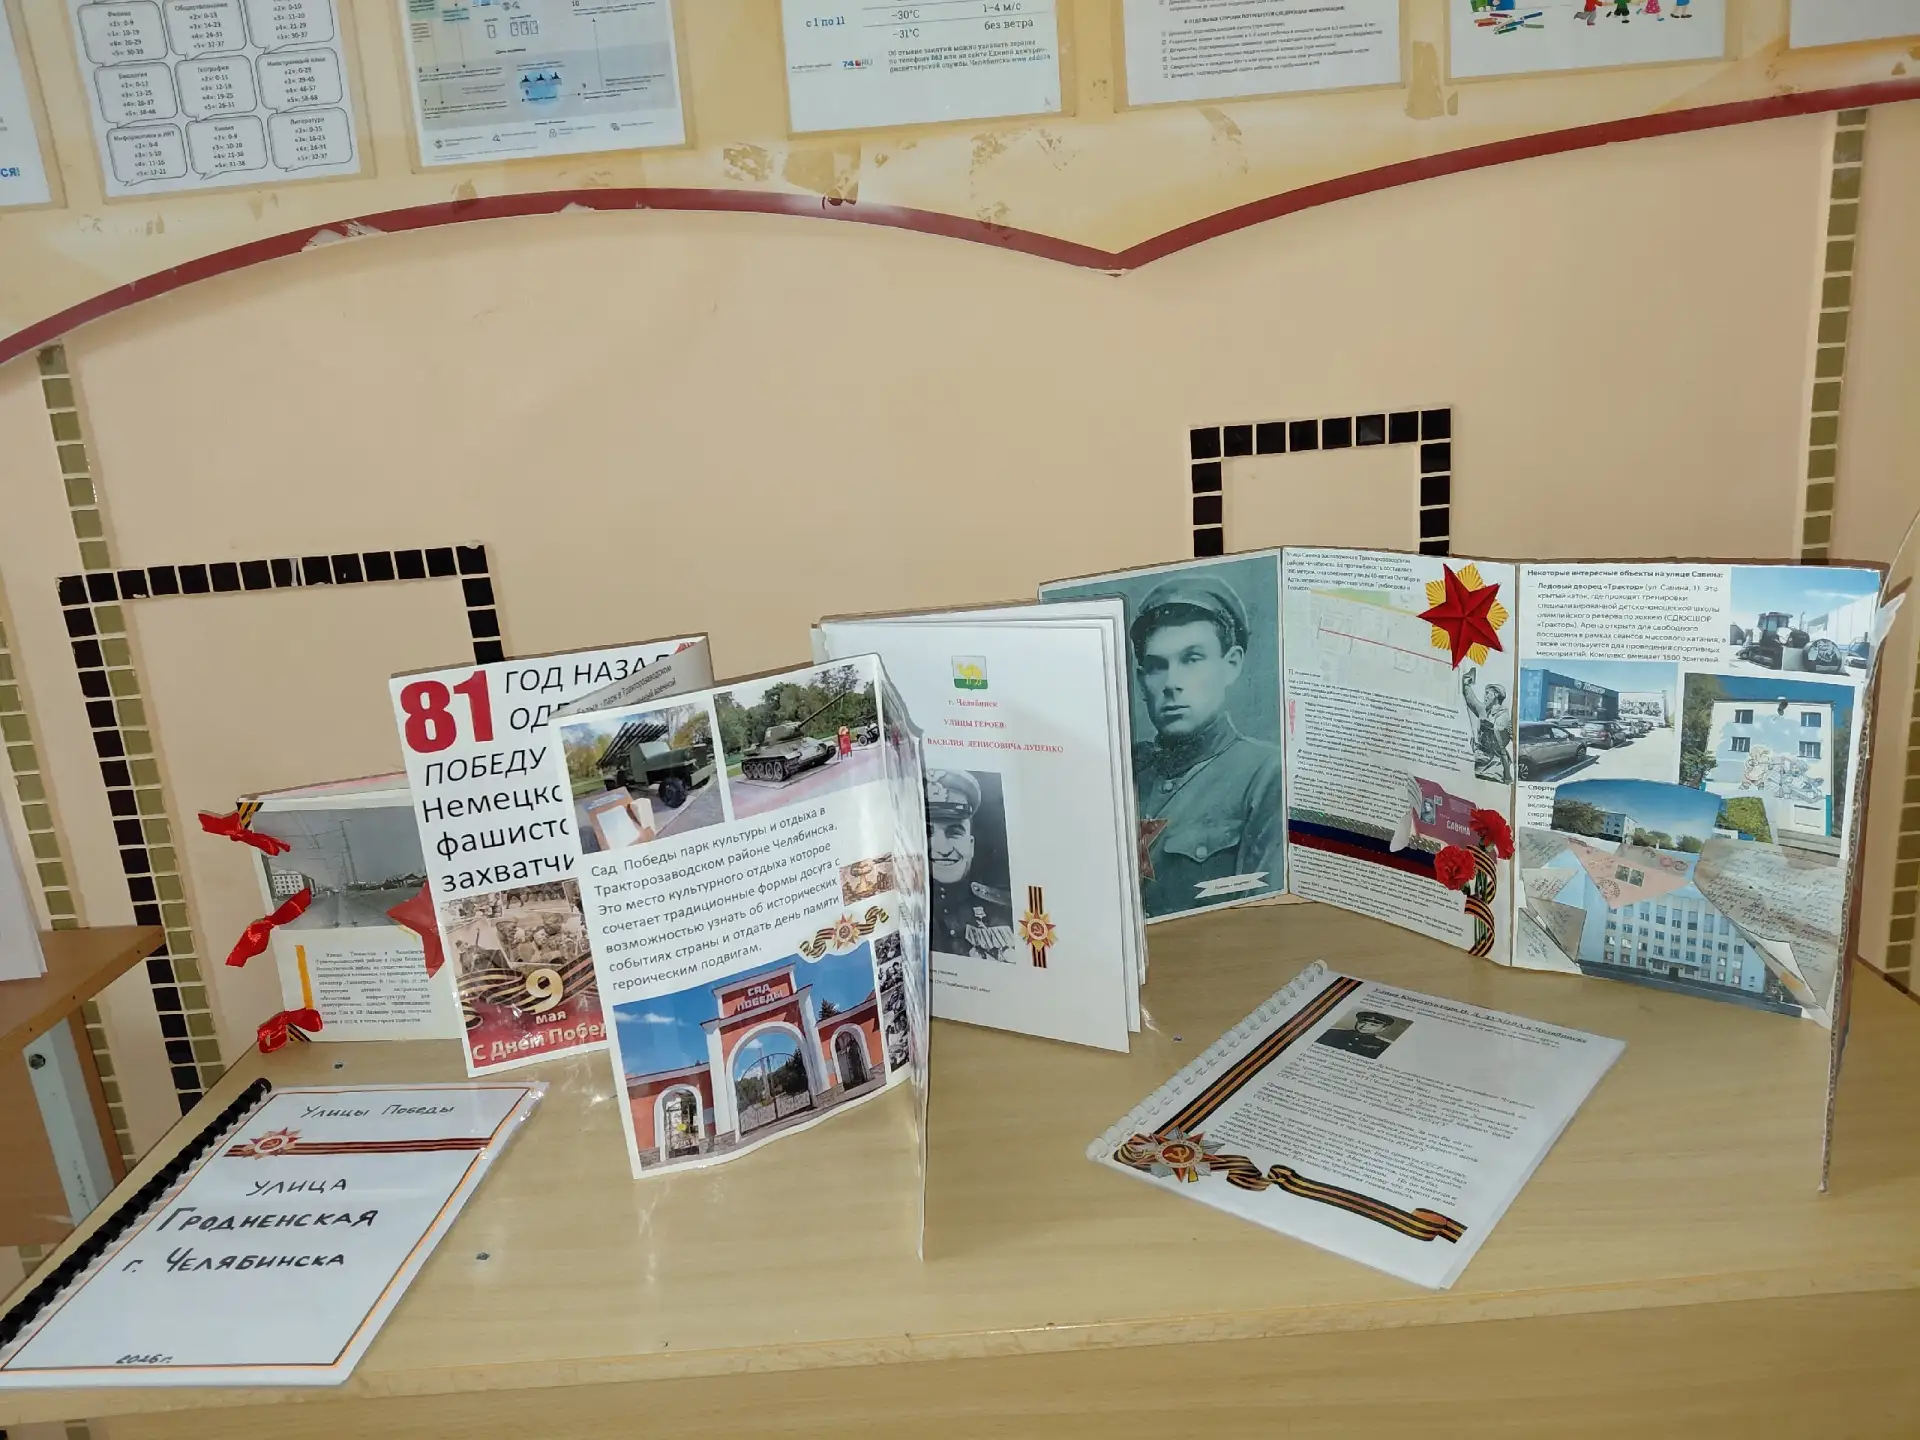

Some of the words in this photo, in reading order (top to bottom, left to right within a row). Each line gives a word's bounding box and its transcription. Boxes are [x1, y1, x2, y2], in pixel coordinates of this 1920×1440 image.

[821, 19, 834, 27] по
[836, 15, 845, 25] 11
[984, 20, 1001, 31] без
[1004, 18, 1034, 31] ветра
[1527, 569, 1570, 577] Некоторые
[1619, 569, 1654, 577] объекты
[1537, 582, 1572, 590] Ледовый
[505, 666, 563, 694] ГОД
[574, 654, 669, 685] НАЗА
[400, 669, 494, 754] 81
[956, 698, 998, 708] Челябинск
[943, 718, 973, 729] УЛИЦЫ
[927, 738, 964, 747] ВАСИЛИЯ
[968, 740, 1022, 751] ДЕНИСОВИЧА
[1023, 744, 1064, 753] ЛУЦЕНКО
[425, 746, 547, 787] ПОБЕДУ
[591, 865, 618, 877] Сад
[623, 851, 677, 871] Победы
[680, 841, 709, 857] парк
[712, 826, 767, 848] культуры
[769, 823, 777, 832] и
[780, 809, 817, 828] отдыха
[819, 807, 826, 816] в
[594, 858, 725, 898] Тракторозаводском
[728, 844, 770, 866] районе
[598, 904, 622, 915] Это
[626, 894, 665, 911] место
[668, 872, 744, 901] культурного
[746, 859, 787, 878] отдыха
[789, 842, 831, 864] которое
[602, 914, 661, 935] сочетает
[663, 888, 755, 922] традиционные
[758, 874, 797, 896] формы
[800, 861, 833, 881] досуга
[834, 858, 841, 867] с
[606, 923, 704, 954] возможностью
[707, 911, 746, 931] узнать
[749, 902, 764, 916] об
[766, 877, 838, 911] исторических
[609, 951, 672, 972] событиях
[675, 939, 719, 958] страны
[722, 934, 730, 943] и
[733, 922, 772, 940] отдать
[774, 912, 801, 928] день
[803, 895, 840, 916] памяти
[612, 963, 698, 991] героическим
[701, 944, 762, 969] подвигам.
[526, 968, 564, 1016] 9
[737, 990, 783, 1012] ПОБЕДЫ
[747, 983, 771, 997] САД
[535, 1009, 567, 1025] мая
[472, 1043, 487, 1060] С
[300, 1105, 369, 1118] Улицы
[381, 1103, 455, 1116] Победы
